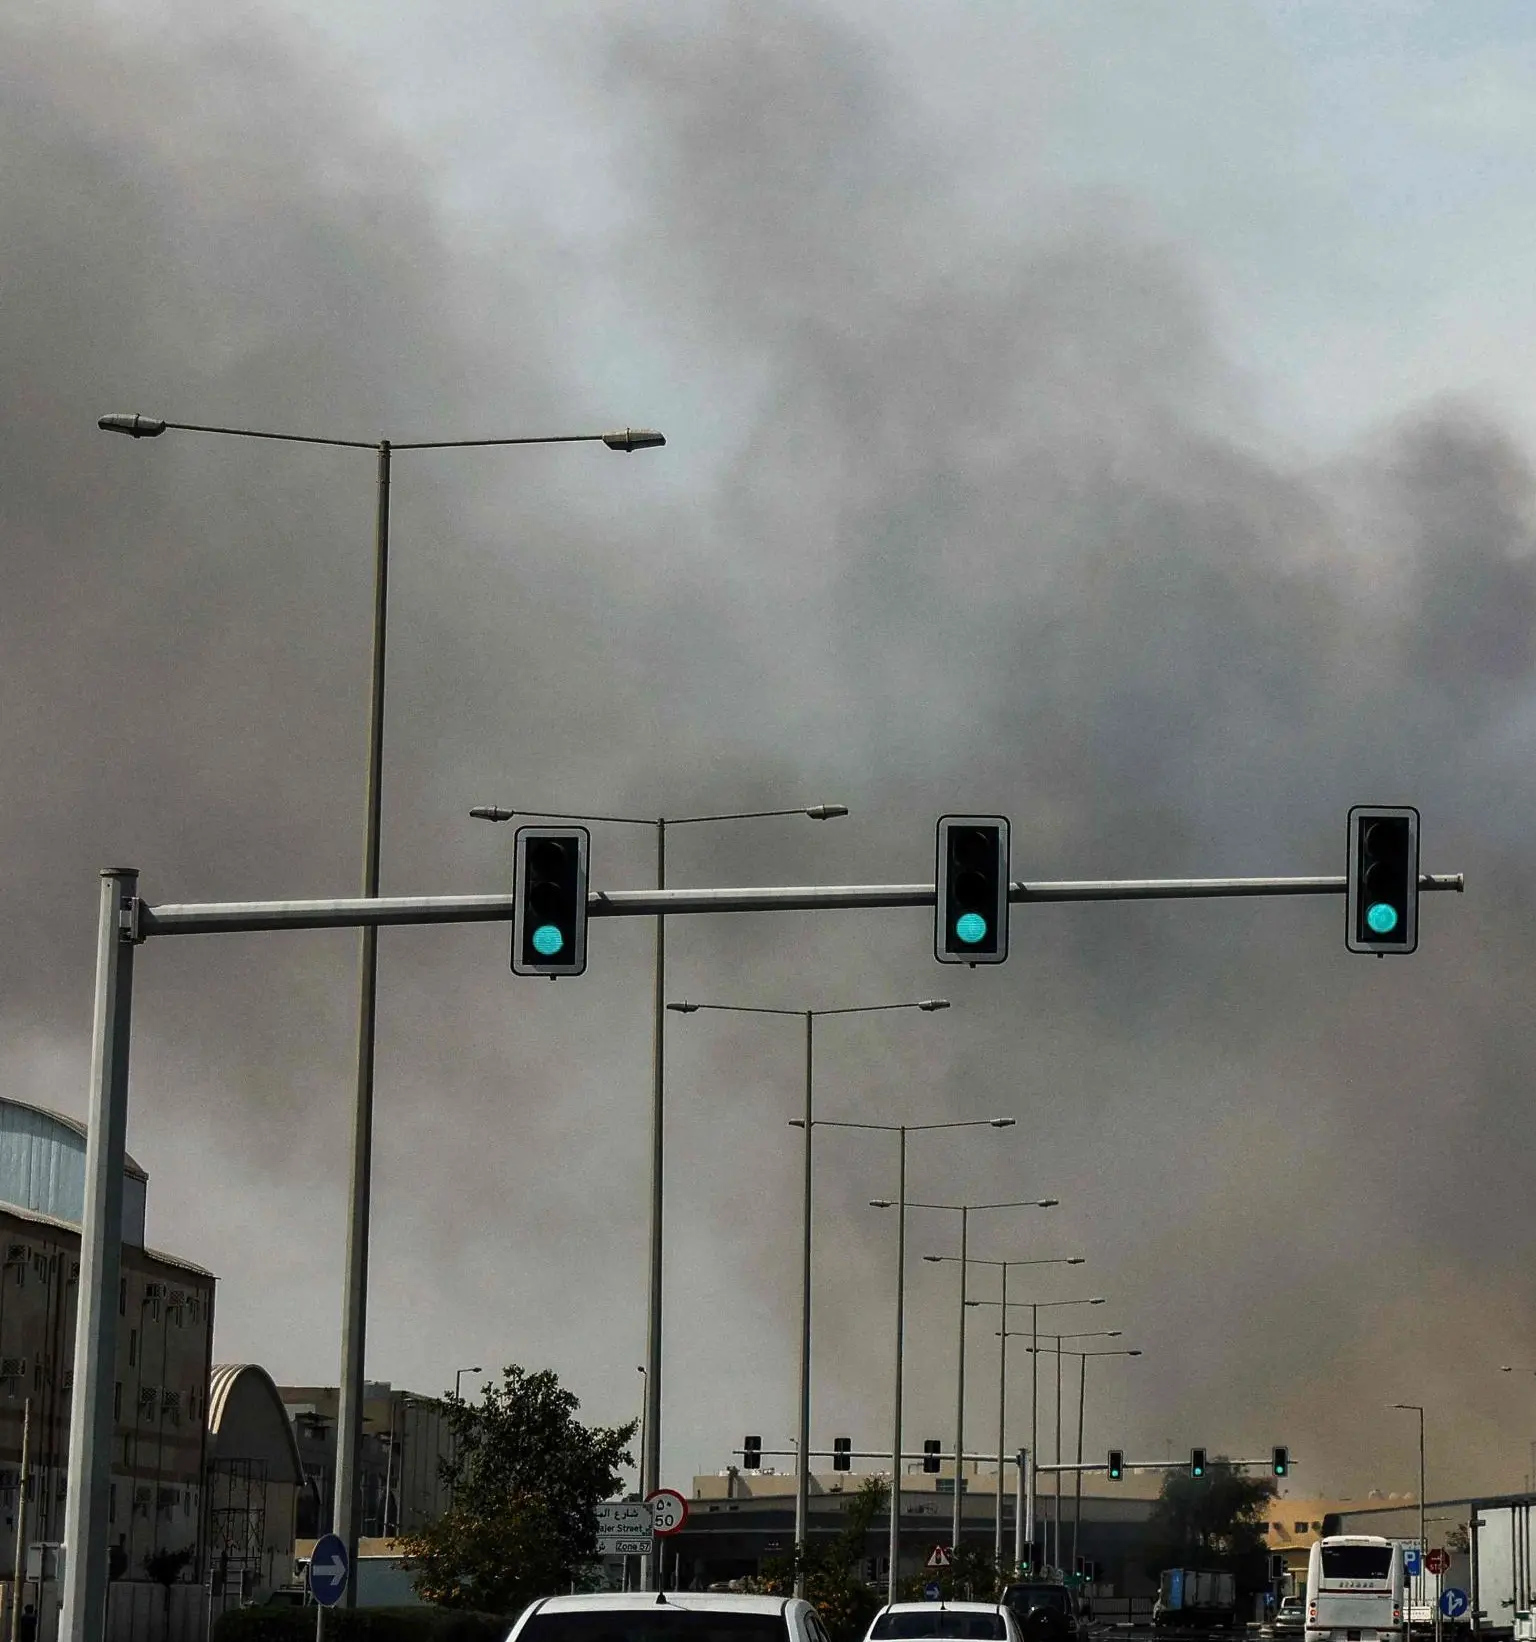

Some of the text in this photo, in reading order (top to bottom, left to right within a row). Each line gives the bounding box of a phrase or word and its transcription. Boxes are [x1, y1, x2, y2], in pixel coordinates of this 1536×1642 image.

[614, 1508, 639, 1520] شارع
[655, 1514, 674, 1527] 50
[617, 1524, 643, 1532] Street
[617, 1543, 638, 1551] Zone
[1404, 1551, 1416, 1566] P
